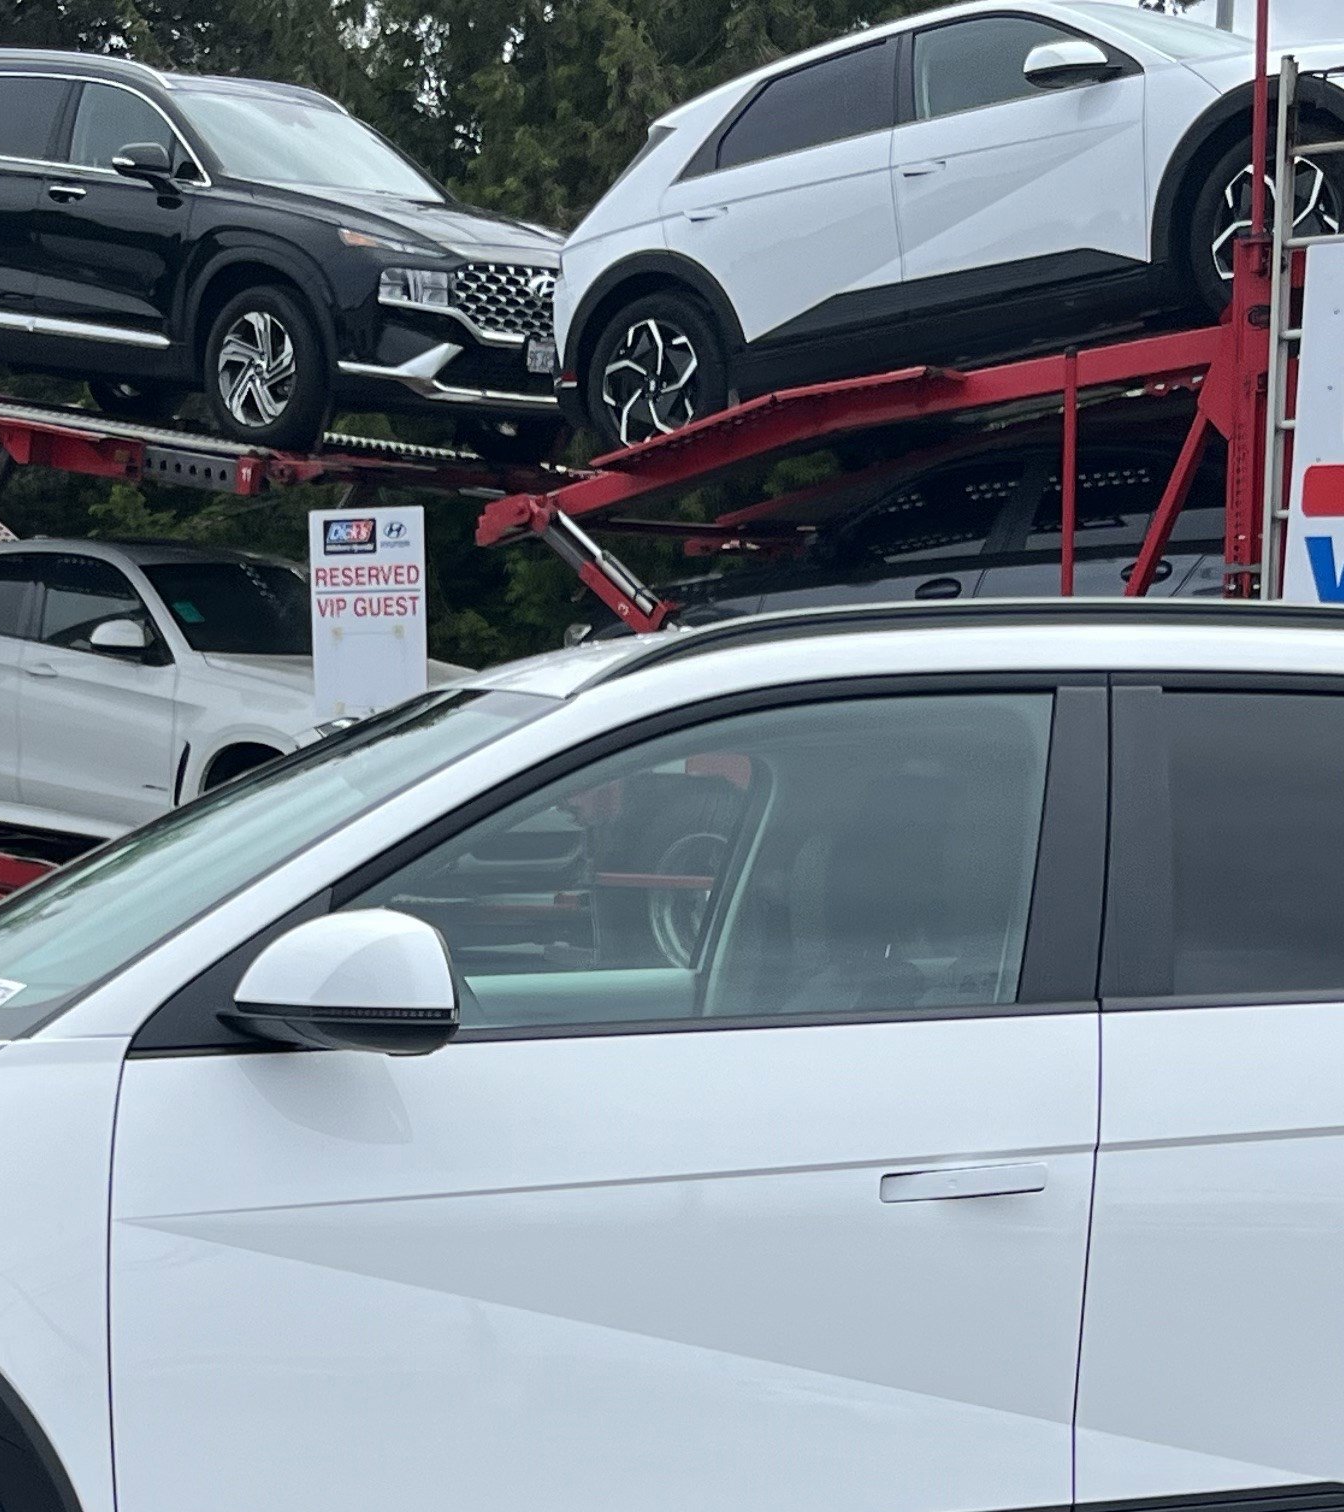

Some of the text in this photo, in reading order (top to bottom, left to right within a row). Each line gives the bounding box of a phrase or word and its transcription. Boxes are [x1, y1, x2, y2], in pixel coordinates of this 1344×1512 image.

[315, 564, 420, 587] RESERVED
[317, 596, 420, 618] VIP GUEST
